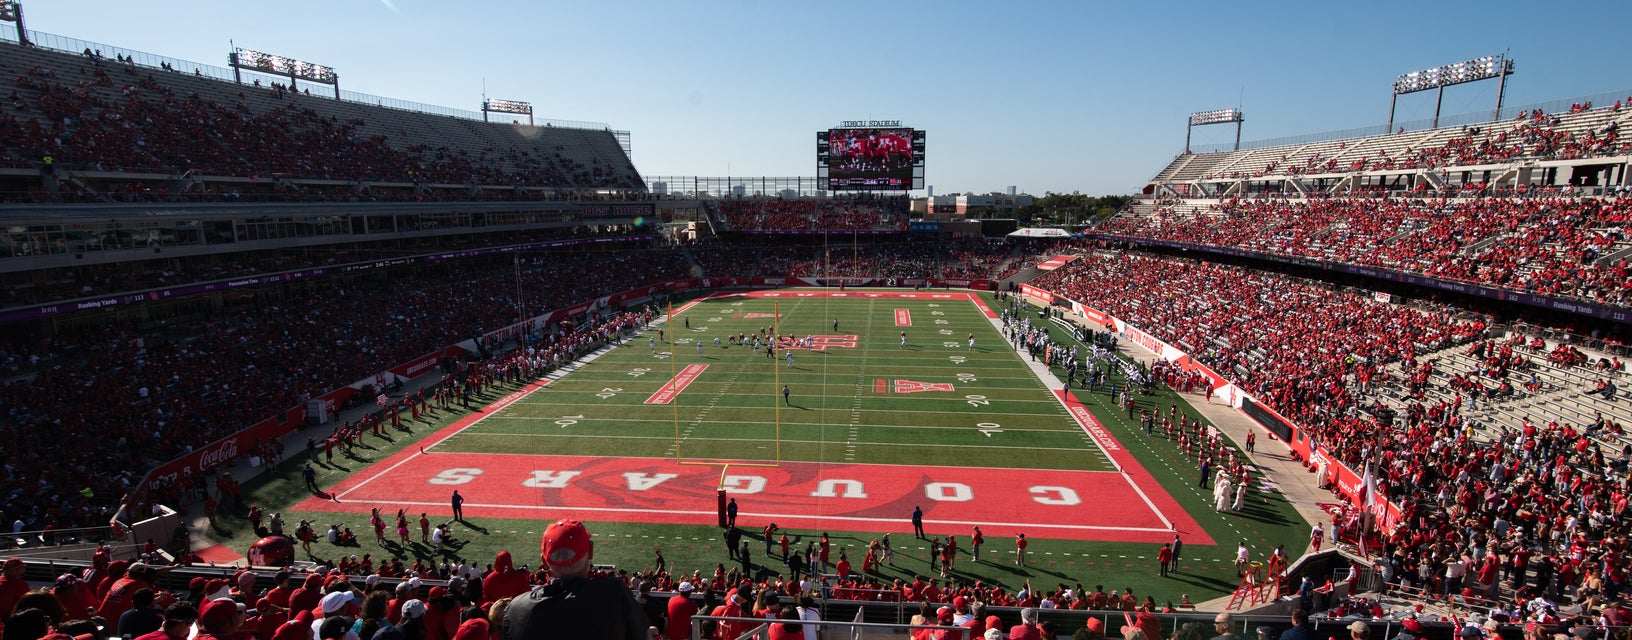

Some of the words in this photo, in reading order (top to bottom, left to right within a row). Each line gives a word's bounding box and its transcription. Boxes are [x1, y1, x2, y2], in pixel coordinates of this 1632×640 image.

[78, 299, 101, 310] Rushing
[101, 298, 117, 306] Yards
[1553, 301, 1577, 313] Rushing
[1577, 305, 1593, 314] Yards
[1613, 312, 1625, 320] 113
[965, 395, 989, 405] 20
[554, 414, 584, 426] 10
[976, 422, 1003, 435] 10
[200, 438, 238, 471] Coca-Cola
[427, 467, 1084, 507] COUGARS
